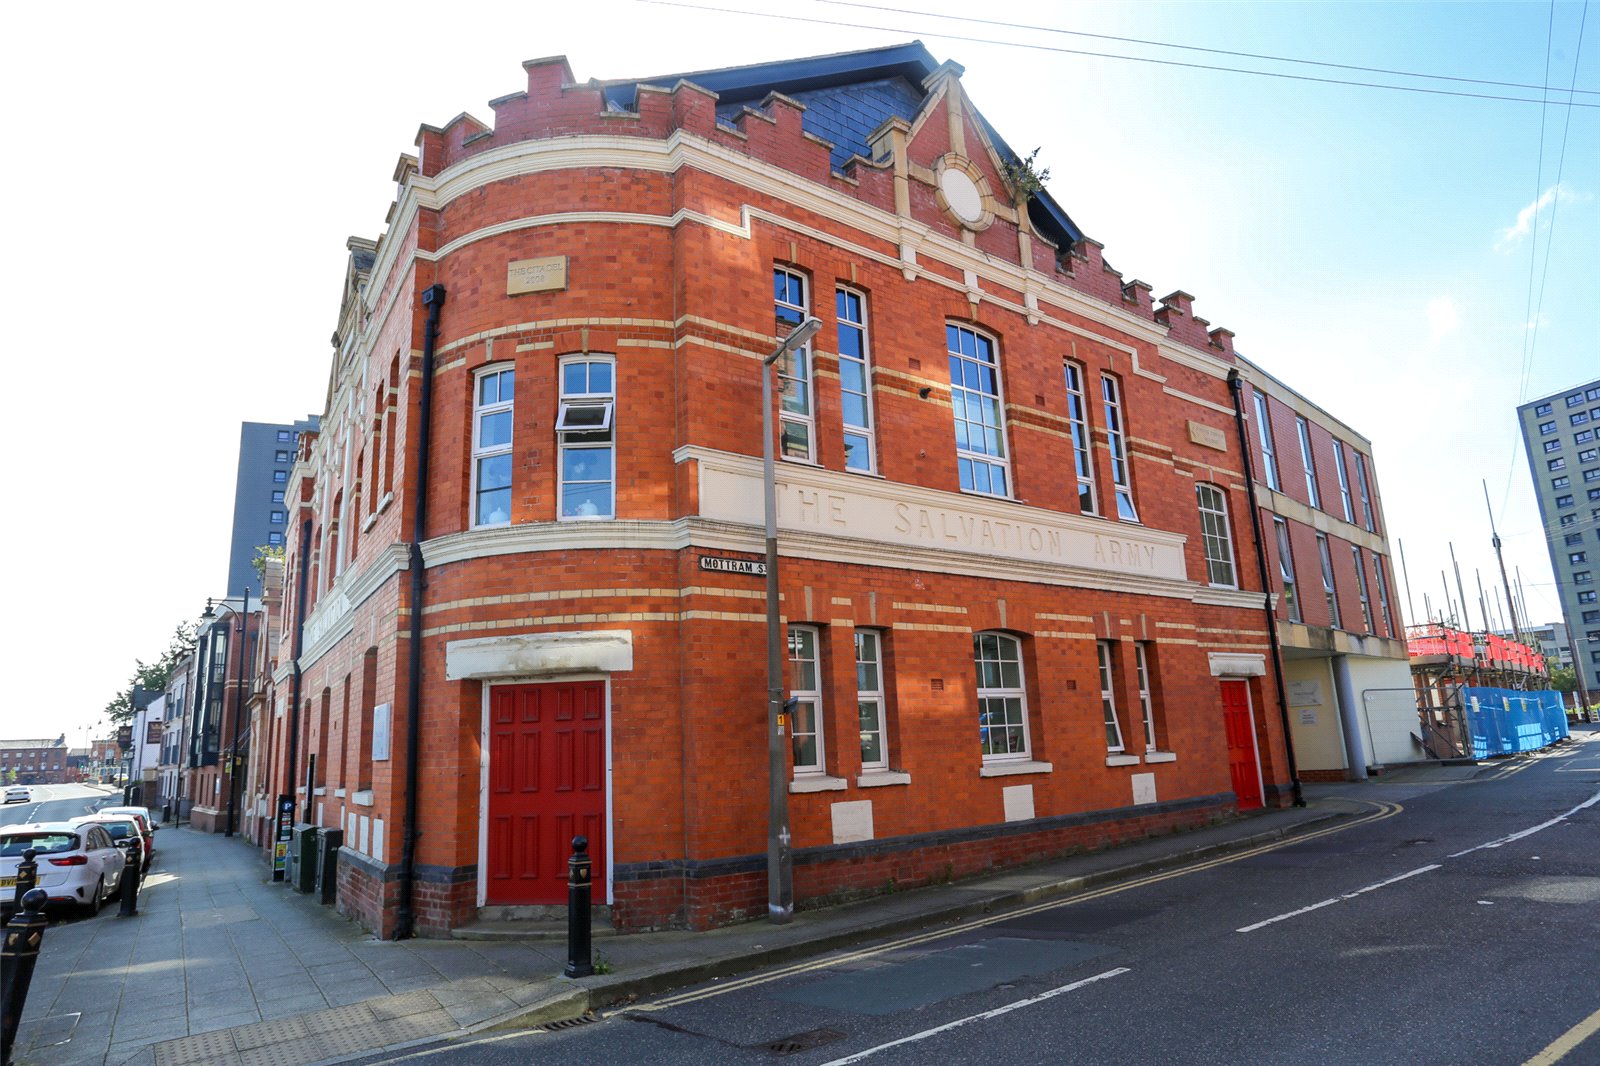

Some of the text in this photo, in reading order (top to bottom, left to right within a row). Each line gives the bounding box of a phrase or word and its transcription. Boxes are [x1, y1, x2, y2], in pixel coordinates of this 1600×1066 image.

[775, 483, 1155, 570] THE SALVATION ARMY
[704, 558, 753, 573] MOTTRAM
